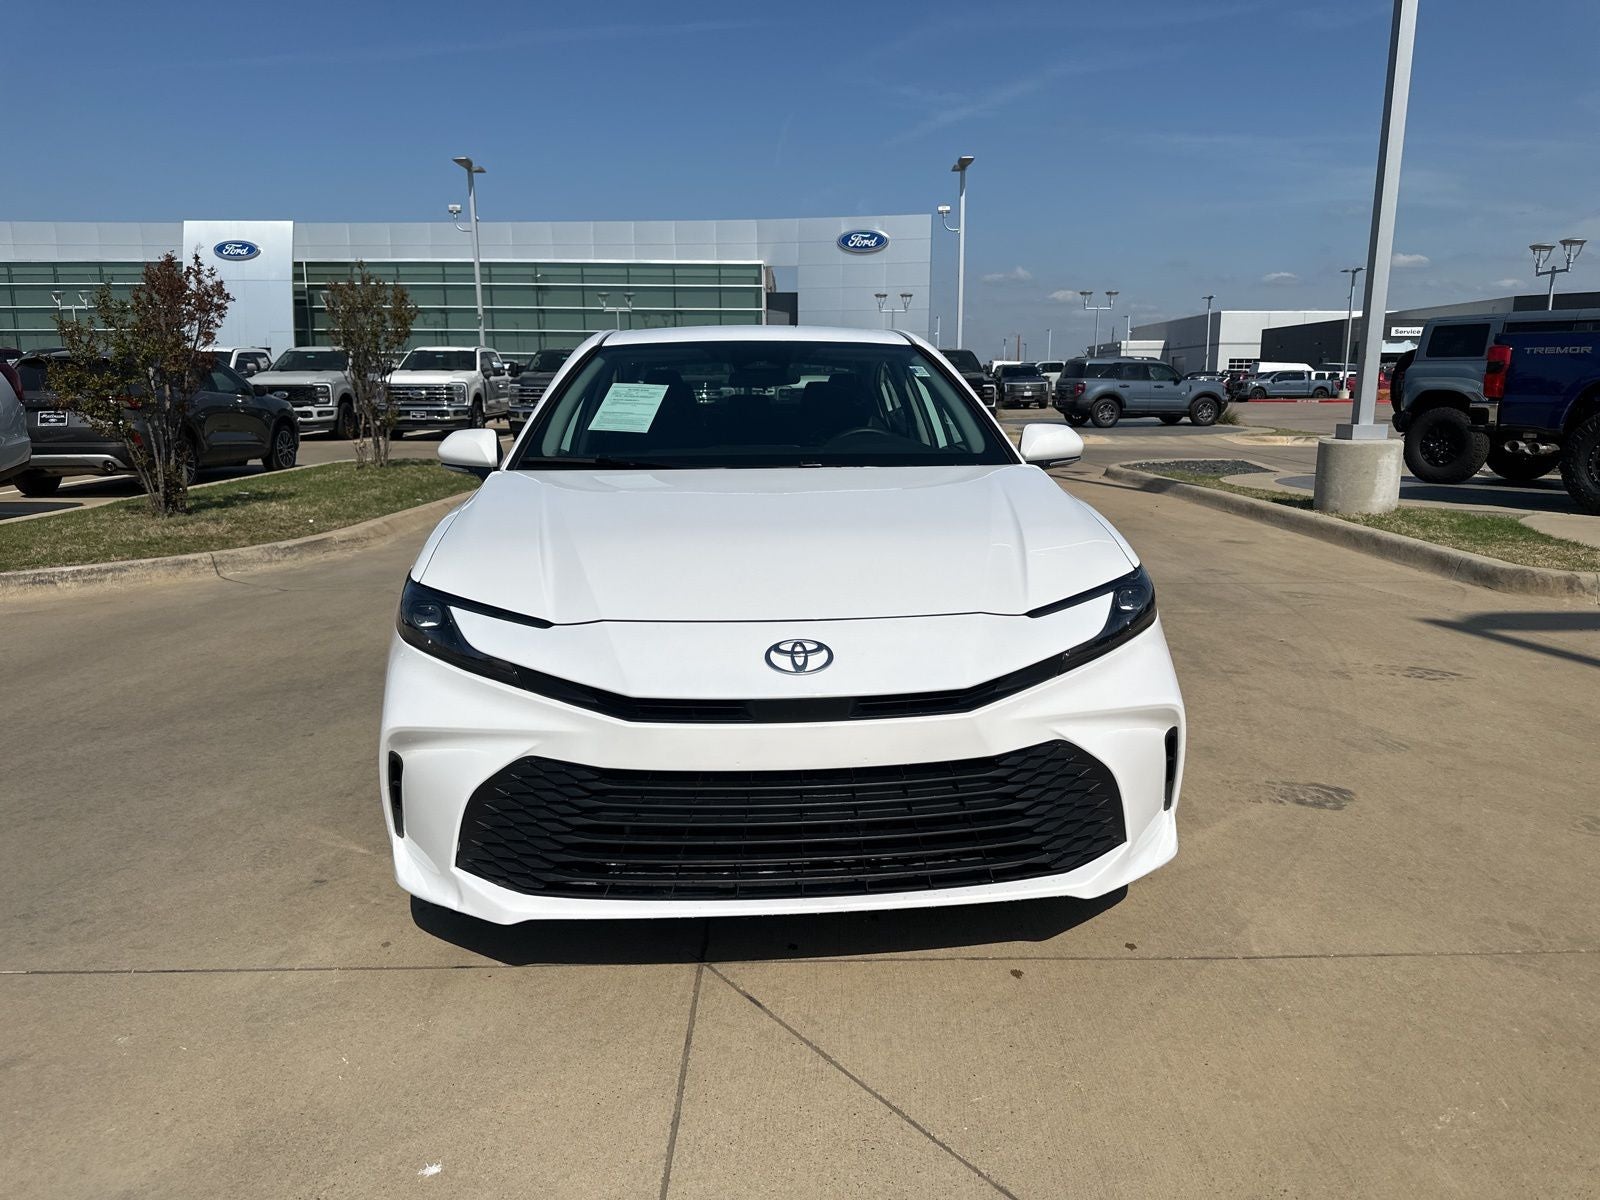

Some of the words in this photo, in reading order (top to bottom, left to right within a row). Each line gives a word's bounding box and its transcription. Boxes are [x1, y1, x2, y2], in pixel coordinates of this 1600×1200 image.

[848, 233, 877, 247] Ford
[222, 243, 249, 255] Ford
[1524, 346, 1593, 354] TREMOR
